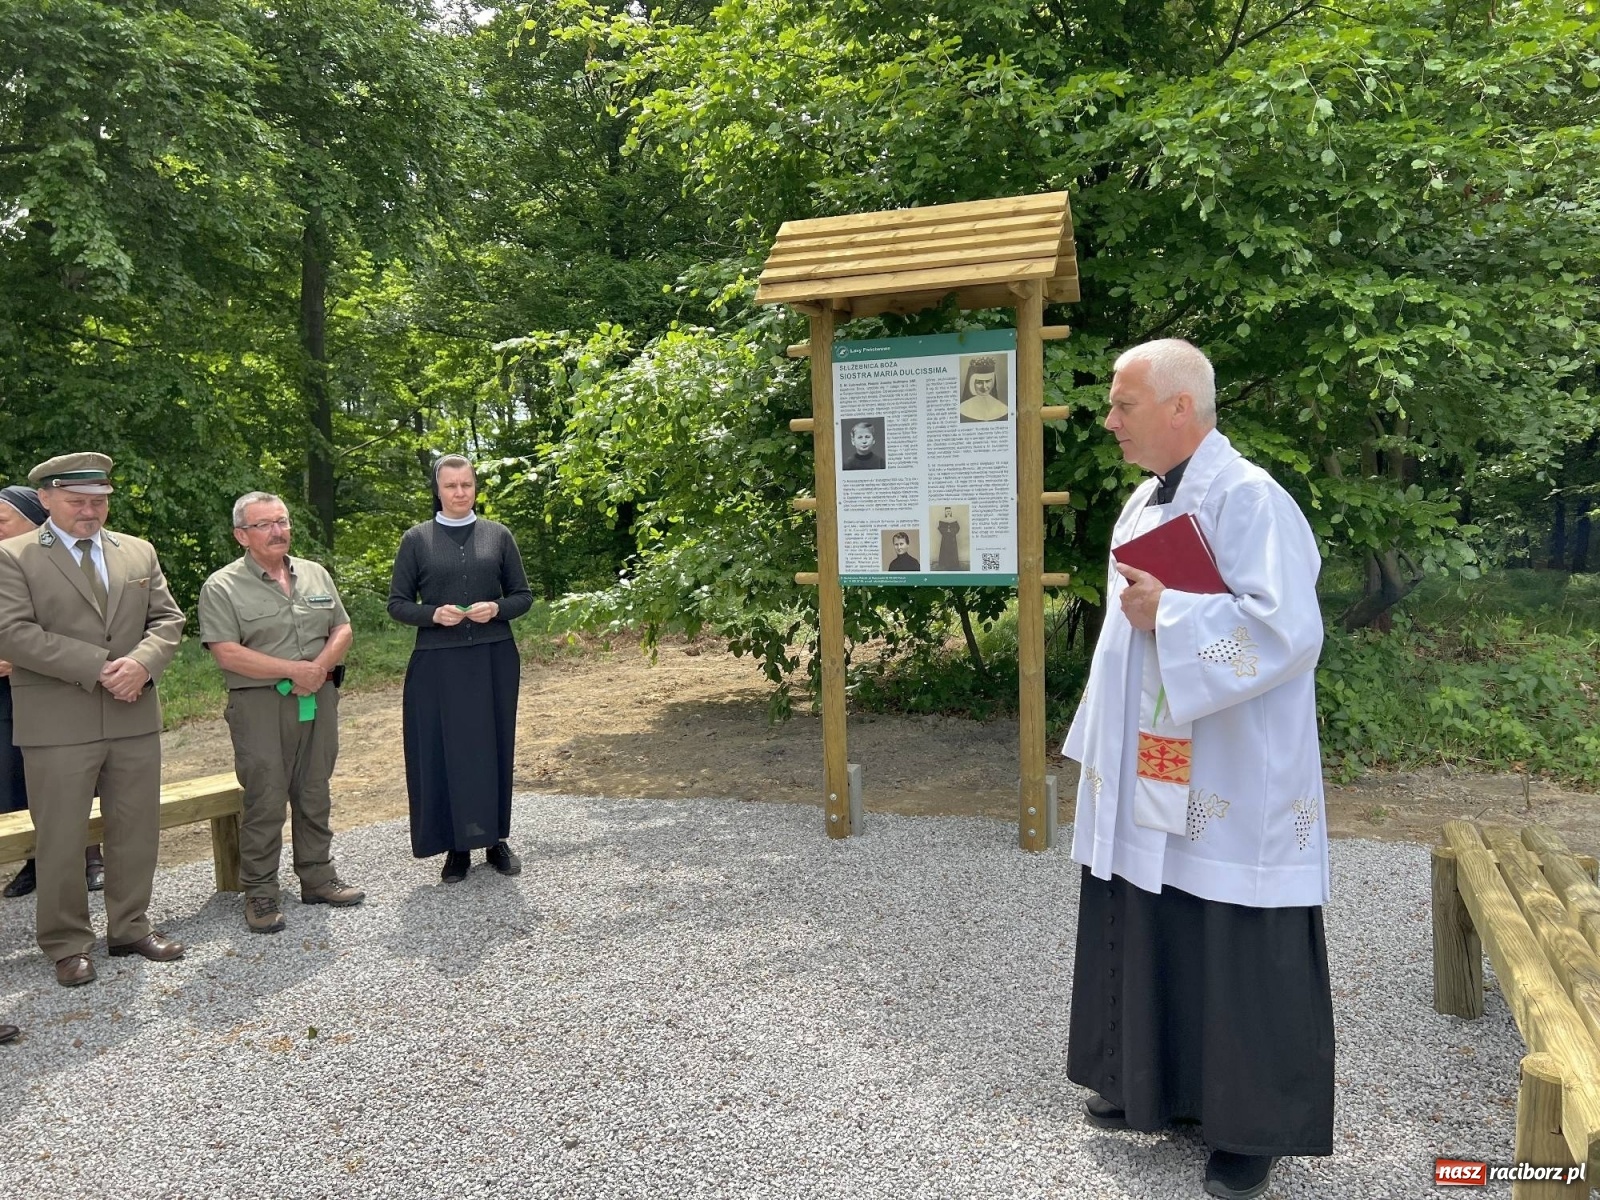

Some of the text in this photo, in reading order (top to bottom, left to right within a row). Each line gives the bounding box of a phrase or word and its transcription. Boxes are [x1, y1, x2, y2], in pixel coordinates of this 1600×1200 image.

[839, 366, 948, 380] SIOSTRA MARIA DULCISSIMA
